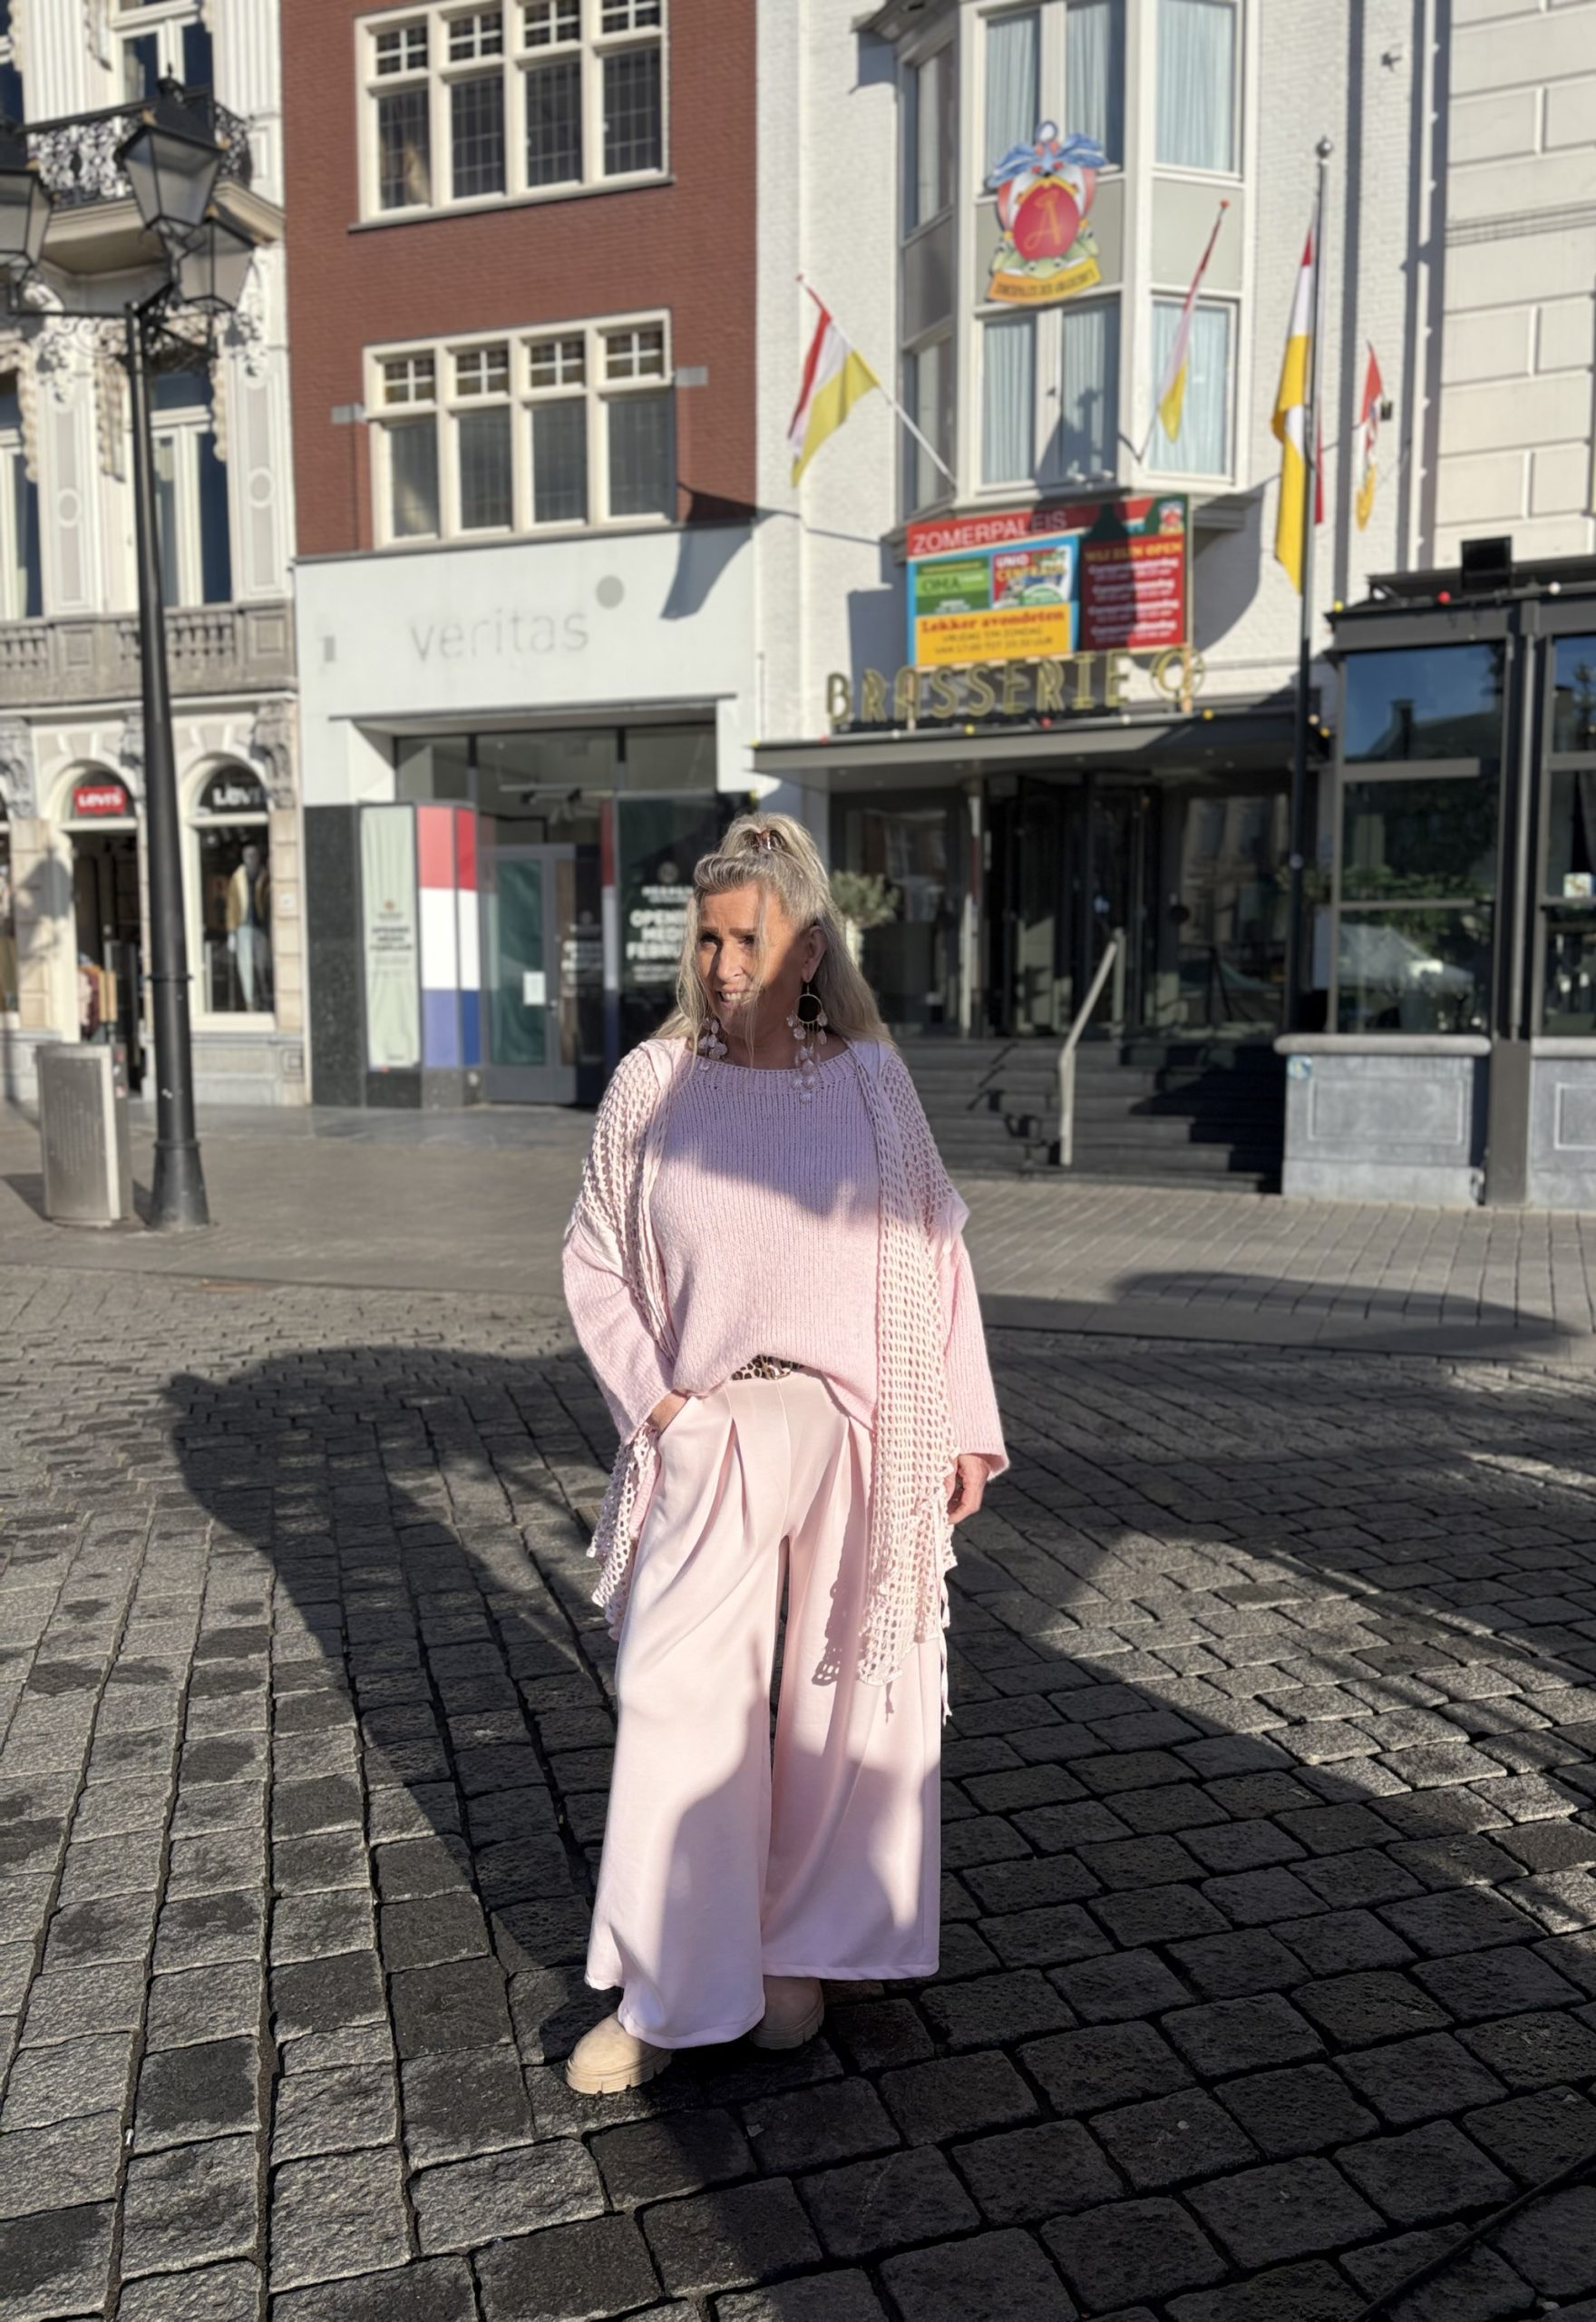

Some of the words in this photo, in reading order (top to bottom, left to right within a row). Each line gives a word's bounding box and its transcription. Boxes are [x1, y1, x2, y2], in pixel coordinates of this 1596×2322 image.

[913, 511, 1067, 554] ZOMERPALEIS
[410, 608, 589, 662] veritas
[921, 618, 977, 634] Lekker
[827, 649, 1130, 724] BRASSERIE
